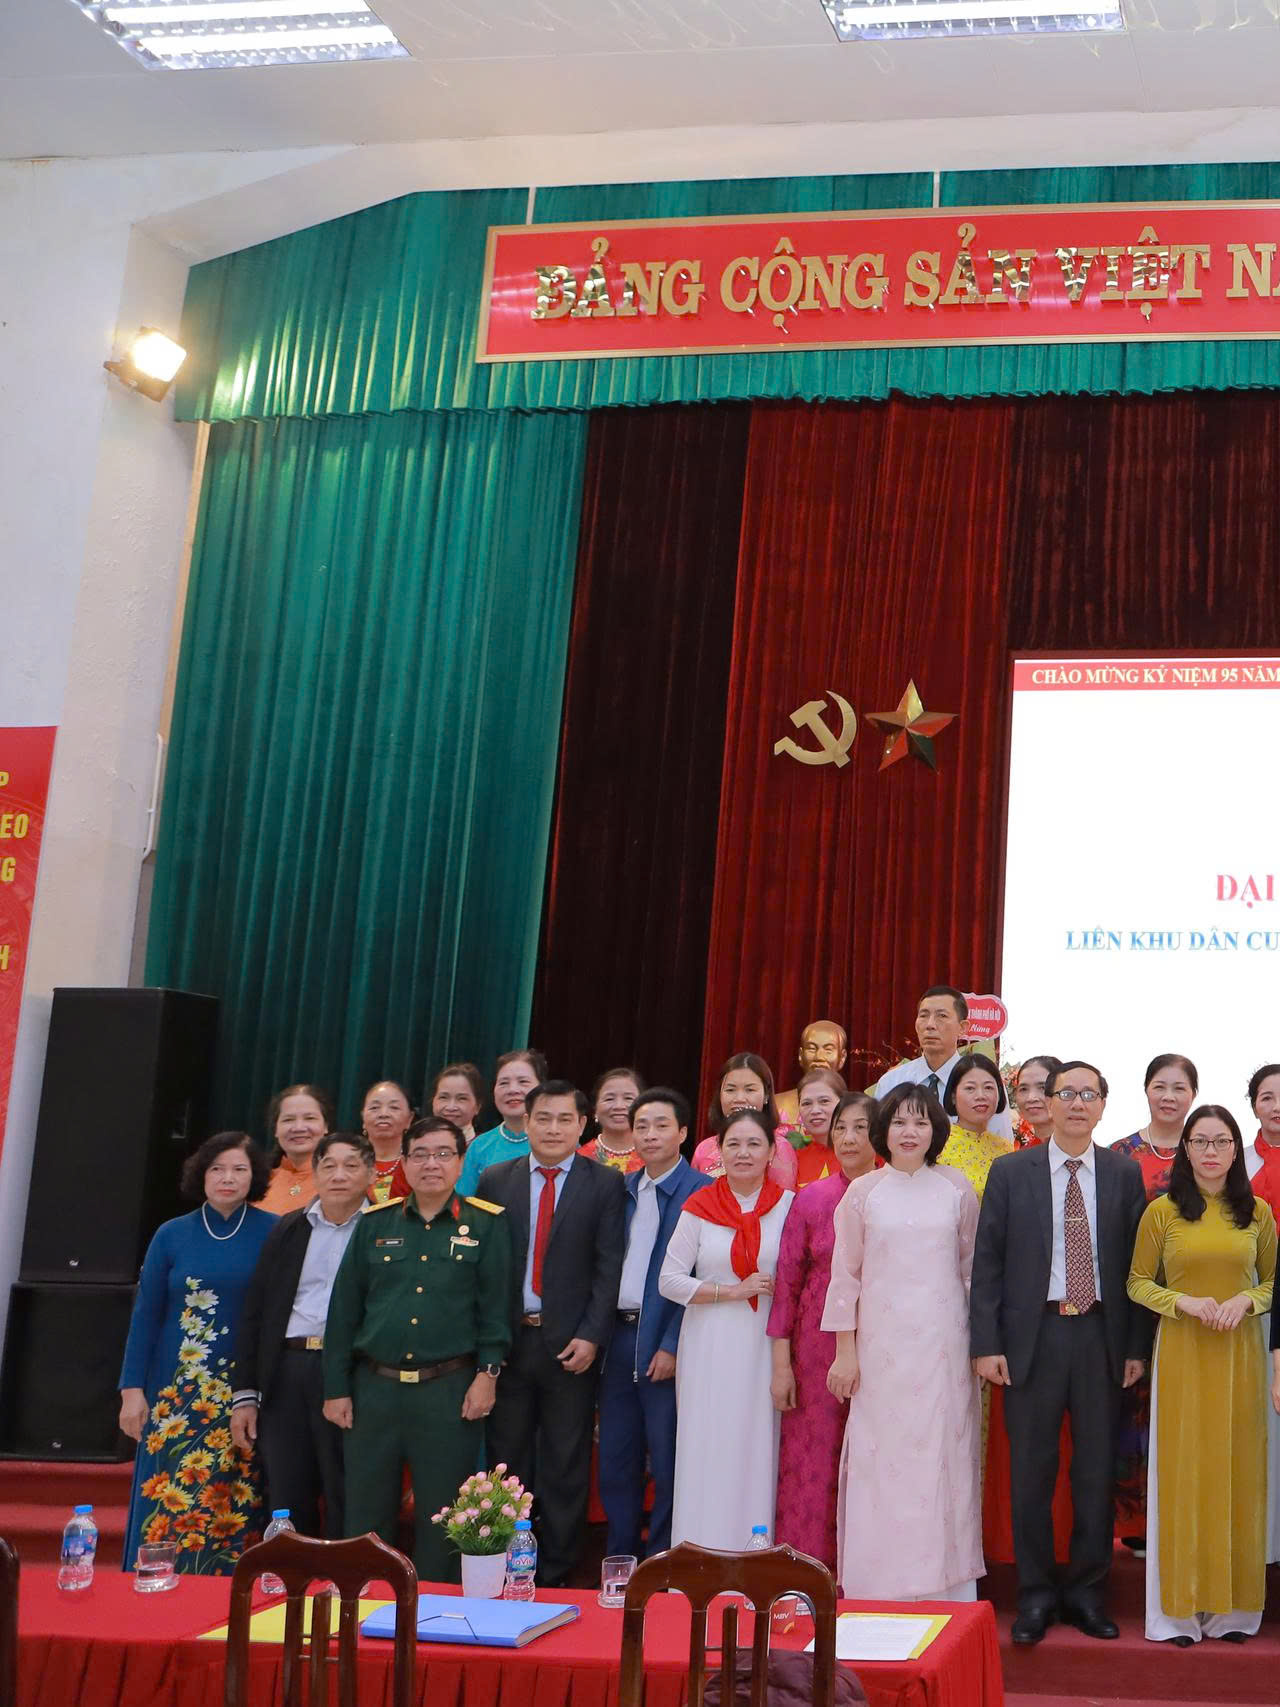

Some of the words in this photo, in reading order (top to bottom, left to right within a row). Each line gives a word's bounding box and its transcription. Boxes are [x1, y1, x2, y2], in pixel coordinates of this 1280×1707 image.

[531, 237, 705, 320] ĐẢNG
[720, 237, 889, 329] CỘNG
[904, 223, 1037, 306] SẢN
[1055, 226, 1210, 316] VIỆT
[1032, 666, 1081, 684] CHÀO
[1086, 666, 1139, 684] MỪNG
[1143, 665, 1168, 683] KỶ
[1172, 666, 1217, 686] NIỆM
[1221, 668, 1238, 682] 95
[1216, 873, 1274, 909] ĐẠI
[1065, 926, 1122, 951] LIÊN
[1130, 931, 1182, 951] KHU
[1189, 926, 1240, 951] DÂN
